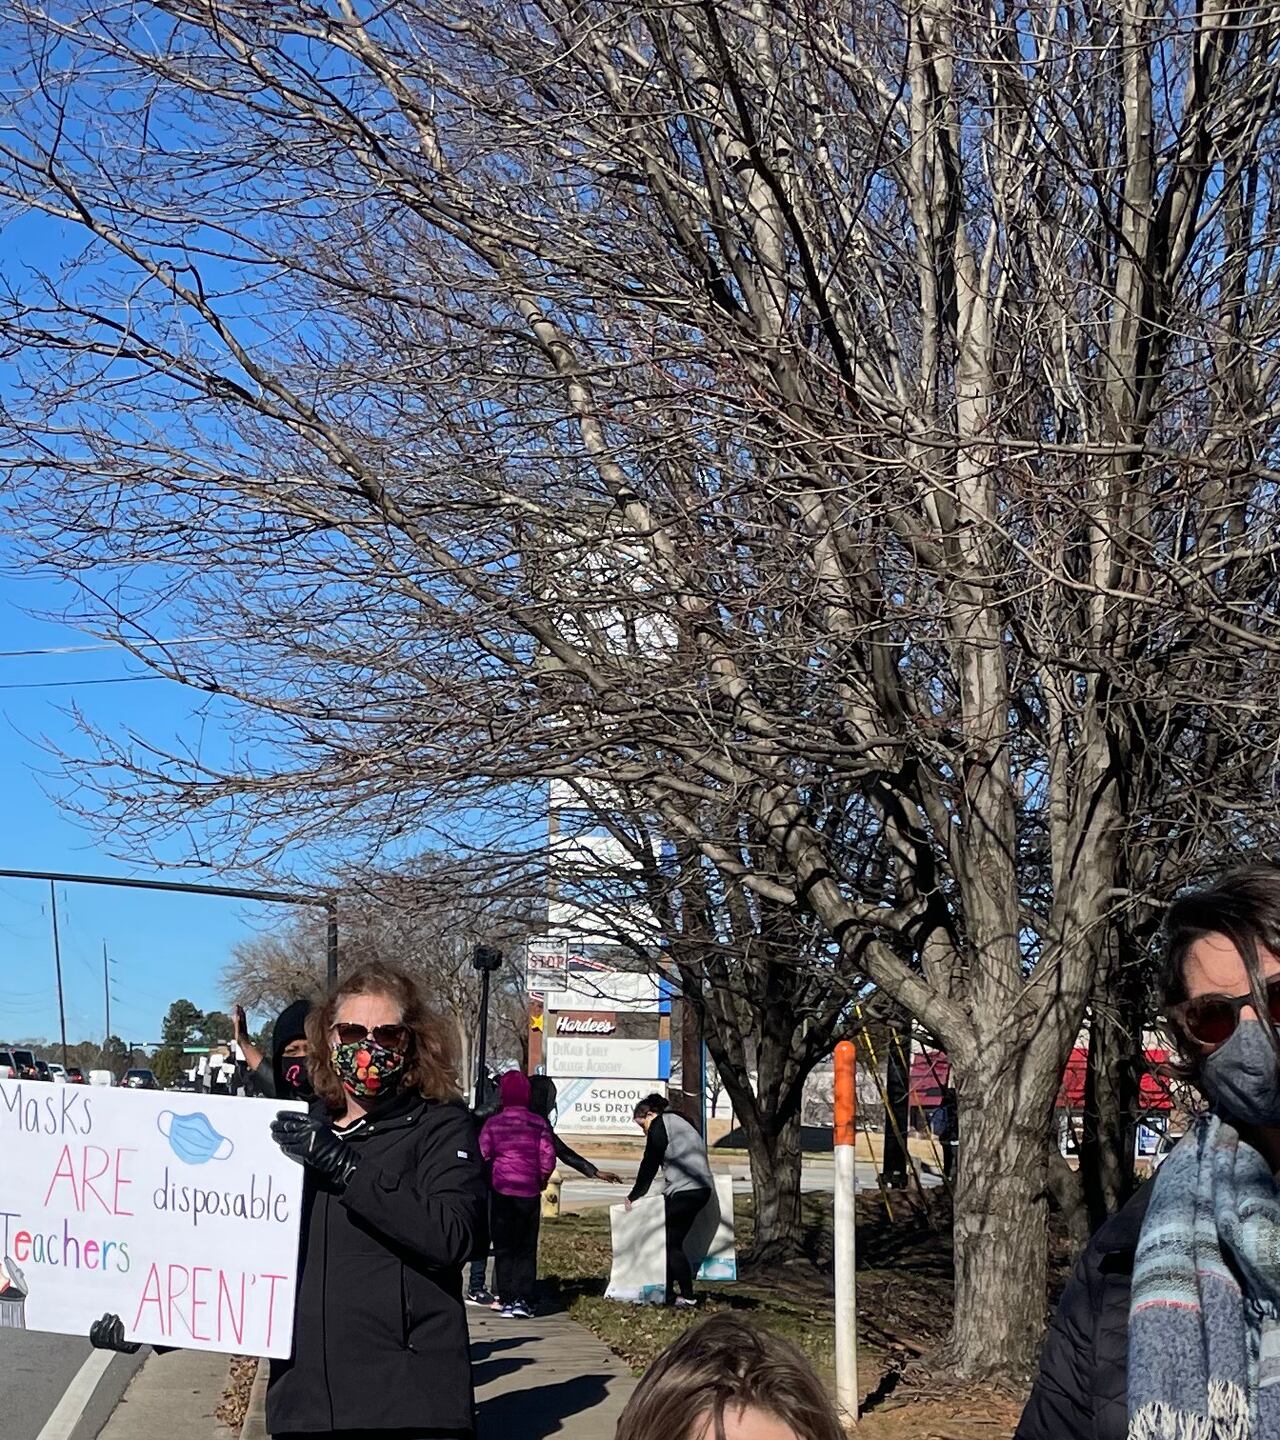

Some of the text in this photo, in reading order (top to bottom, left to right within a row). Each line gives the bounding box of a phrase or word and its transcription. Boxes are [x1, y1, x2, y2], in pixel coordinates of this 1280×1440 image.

[530, 955, 564, 968] STOP
[591, 1089, 644, 1100] SCHOOL
[575, 1102, 601, 1113] BUS
[599, 1115, 634, 1124] 678.67
[43, 1144, 289, 1226] ARE disposable
[132, 1262, 289, 1348] AREN'T
